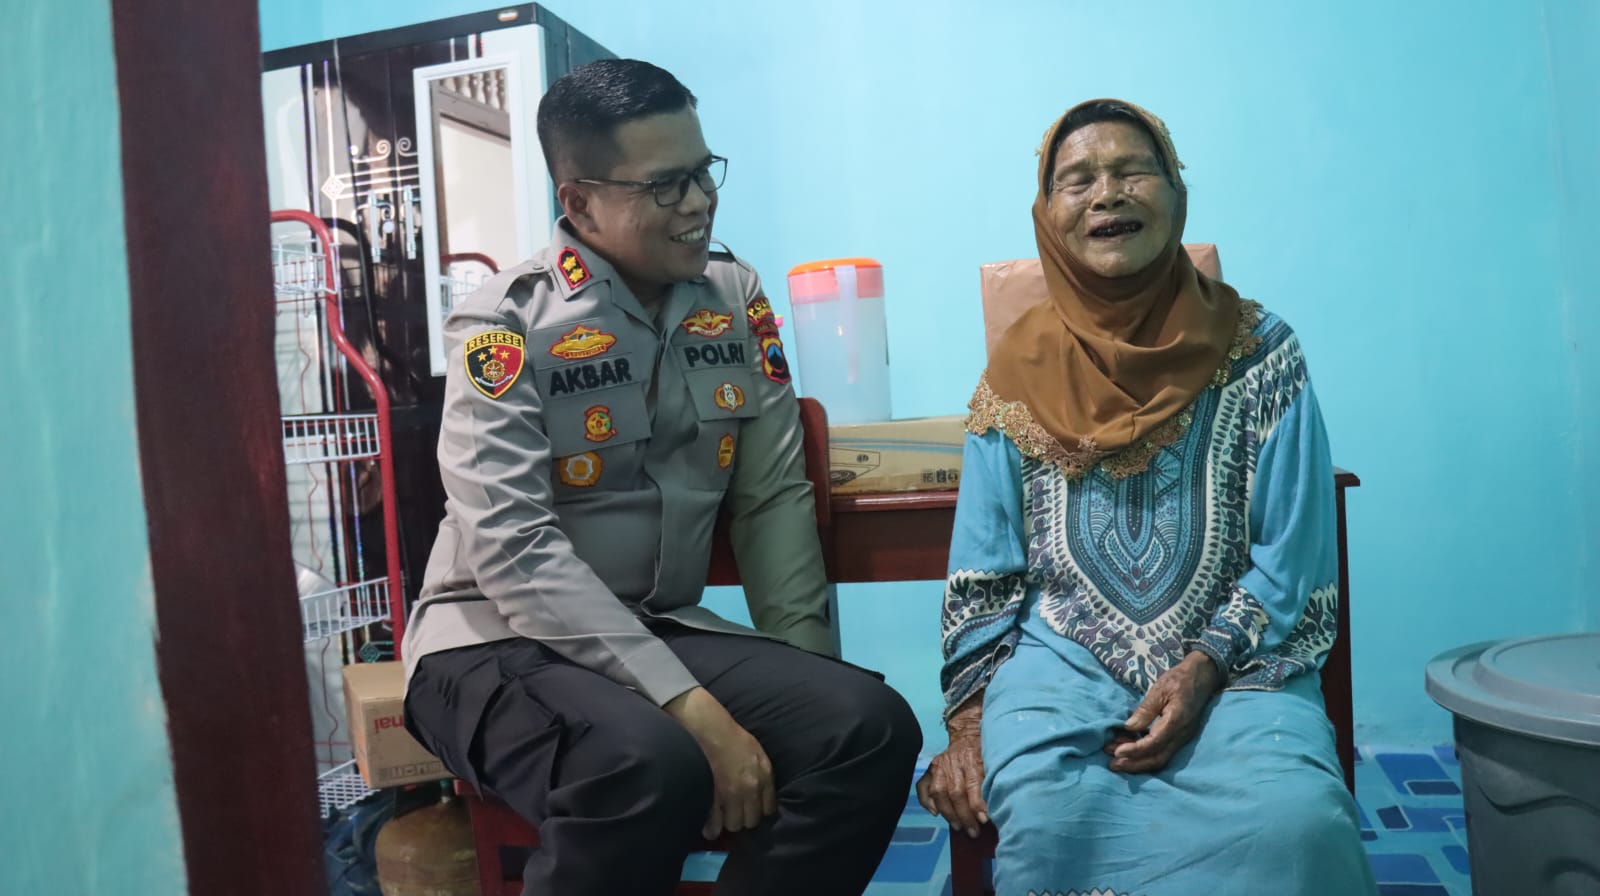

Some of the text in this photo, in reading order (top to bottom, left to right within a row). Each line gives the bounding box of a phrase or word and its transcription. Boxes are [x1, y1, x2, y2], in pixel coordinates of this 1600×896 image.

[468, 333, 520, 350] RESERSE
[683, 342, 745, 368] POLRI
[549, 357, 632, 396] AKBAR
[374, 714, 405, 735] nai
